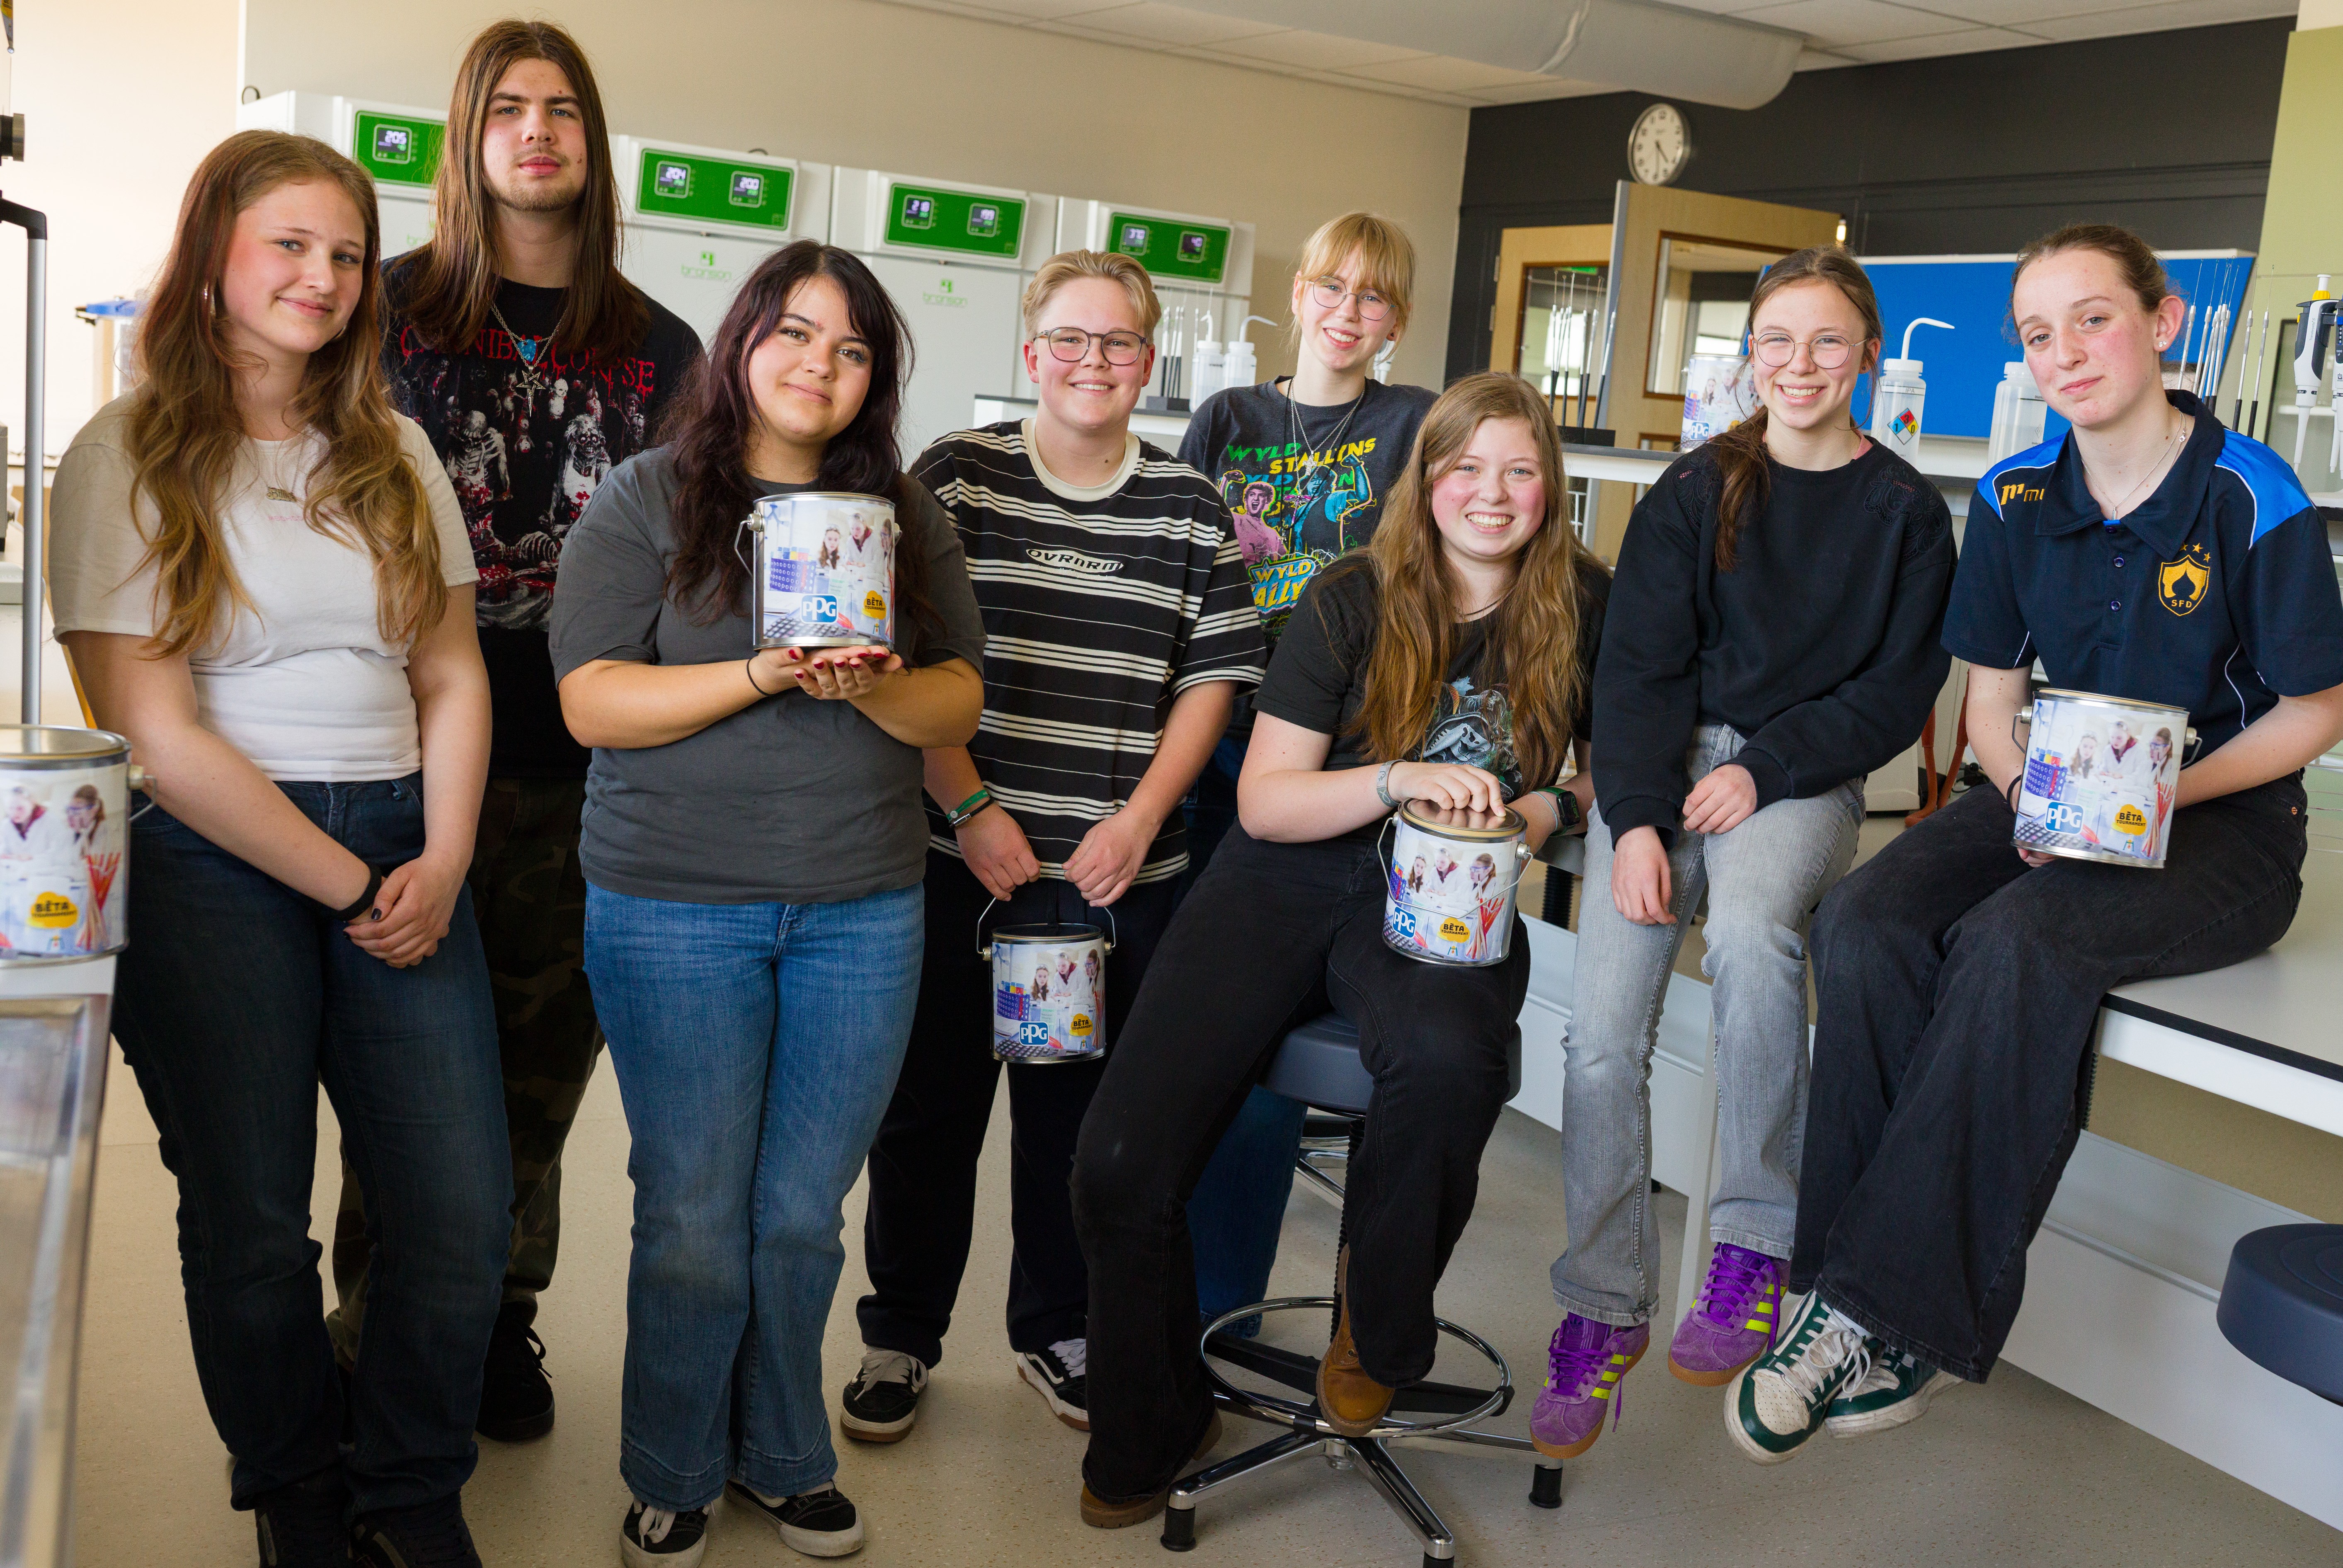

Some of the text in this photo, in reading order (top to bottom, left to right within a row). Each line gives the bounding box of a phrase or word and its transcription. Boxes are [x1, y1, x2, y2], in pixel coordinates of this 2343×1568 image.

[1895, 423, 1915, 434] 1 0
[1904, 415, 1909, 424] 3
[1692, 423, 1708, 438] PPG
[1227, 443, 1301, 462] WYLD
[1270, 438, 1377, 474] STALLYNS
[1255, 562, 1311, 584] WYLD
[802, 597, 836, 620] PPG
[2171, 599, 2192, 608] SFD
[2046, 805, 2082, 829] PPG
[1393, 911, 1415, 933] PPG
[1020, 1024, 1047, 1043] PPG
